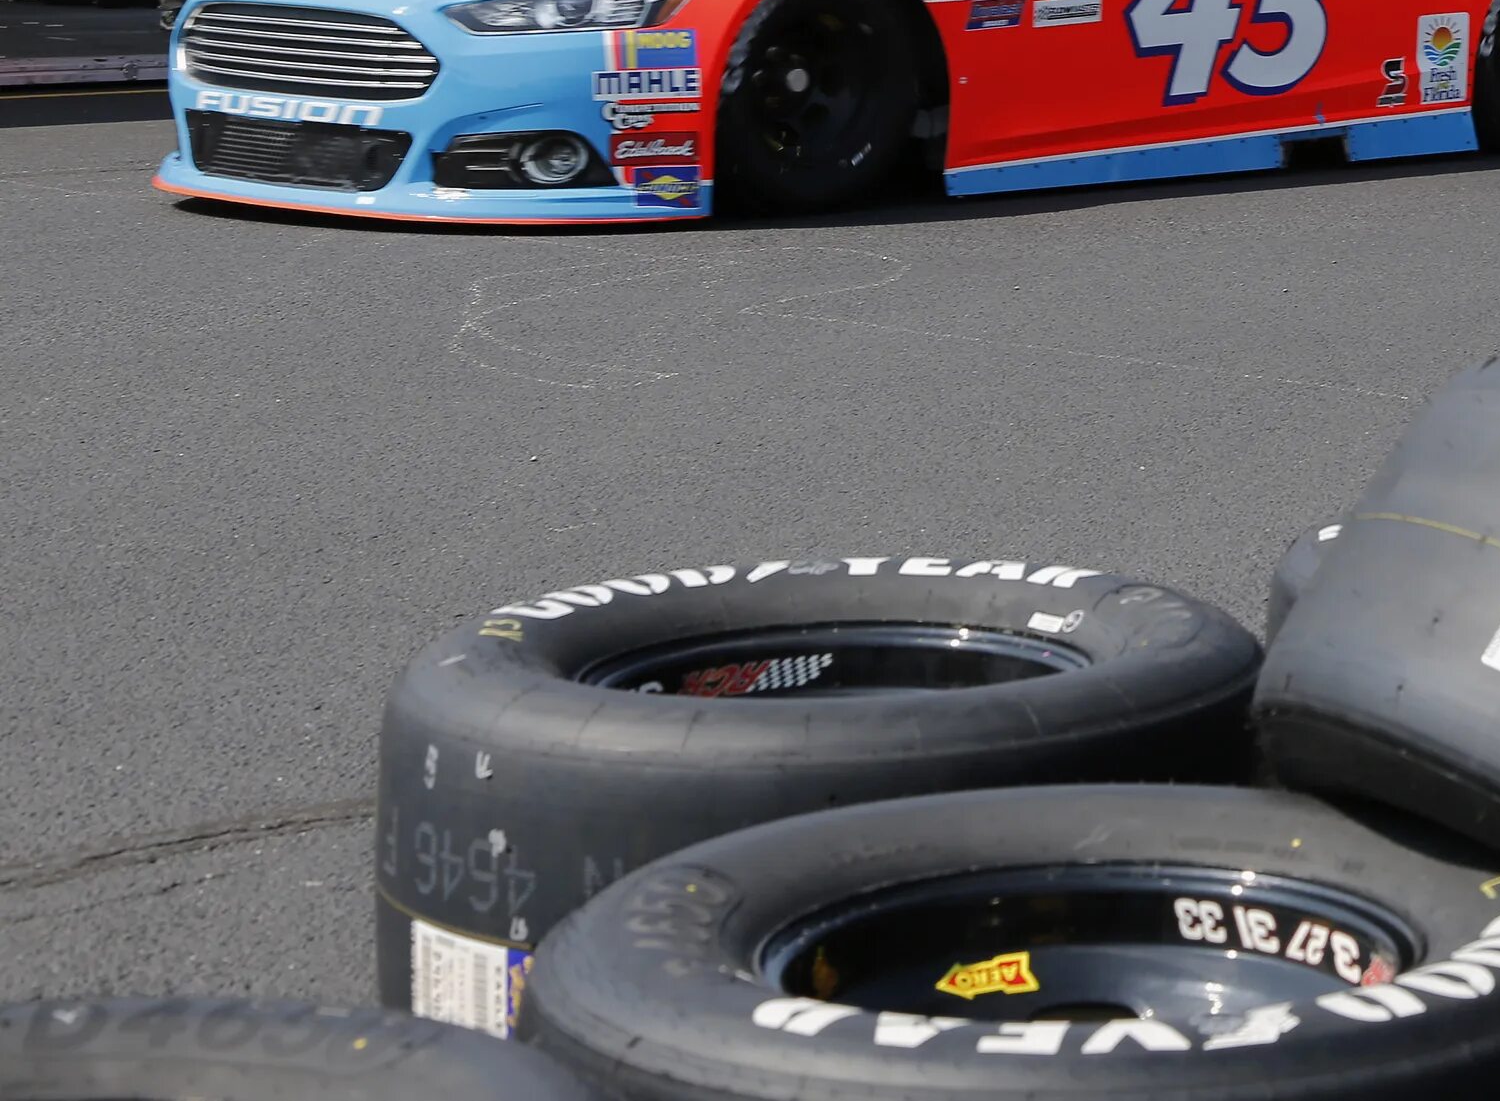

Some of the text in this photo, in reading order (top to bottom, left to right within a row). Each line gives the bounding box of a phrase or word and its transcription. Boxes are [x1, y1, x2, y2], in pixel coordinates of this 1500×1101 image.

[637, 31, 692, 49] MOOG
[597, 69, 699, 95] MAHLE
[1430, 66, 1458, 84] Fresh
[1423, 86, 1462, 103] Florida
[196, 91, 384, 126] FUSION
[413, 819, 539, 914] 4646
[1175, 896, 1364, 988] 3 27 31 33
[954, 970, 1030, 996] AERO
